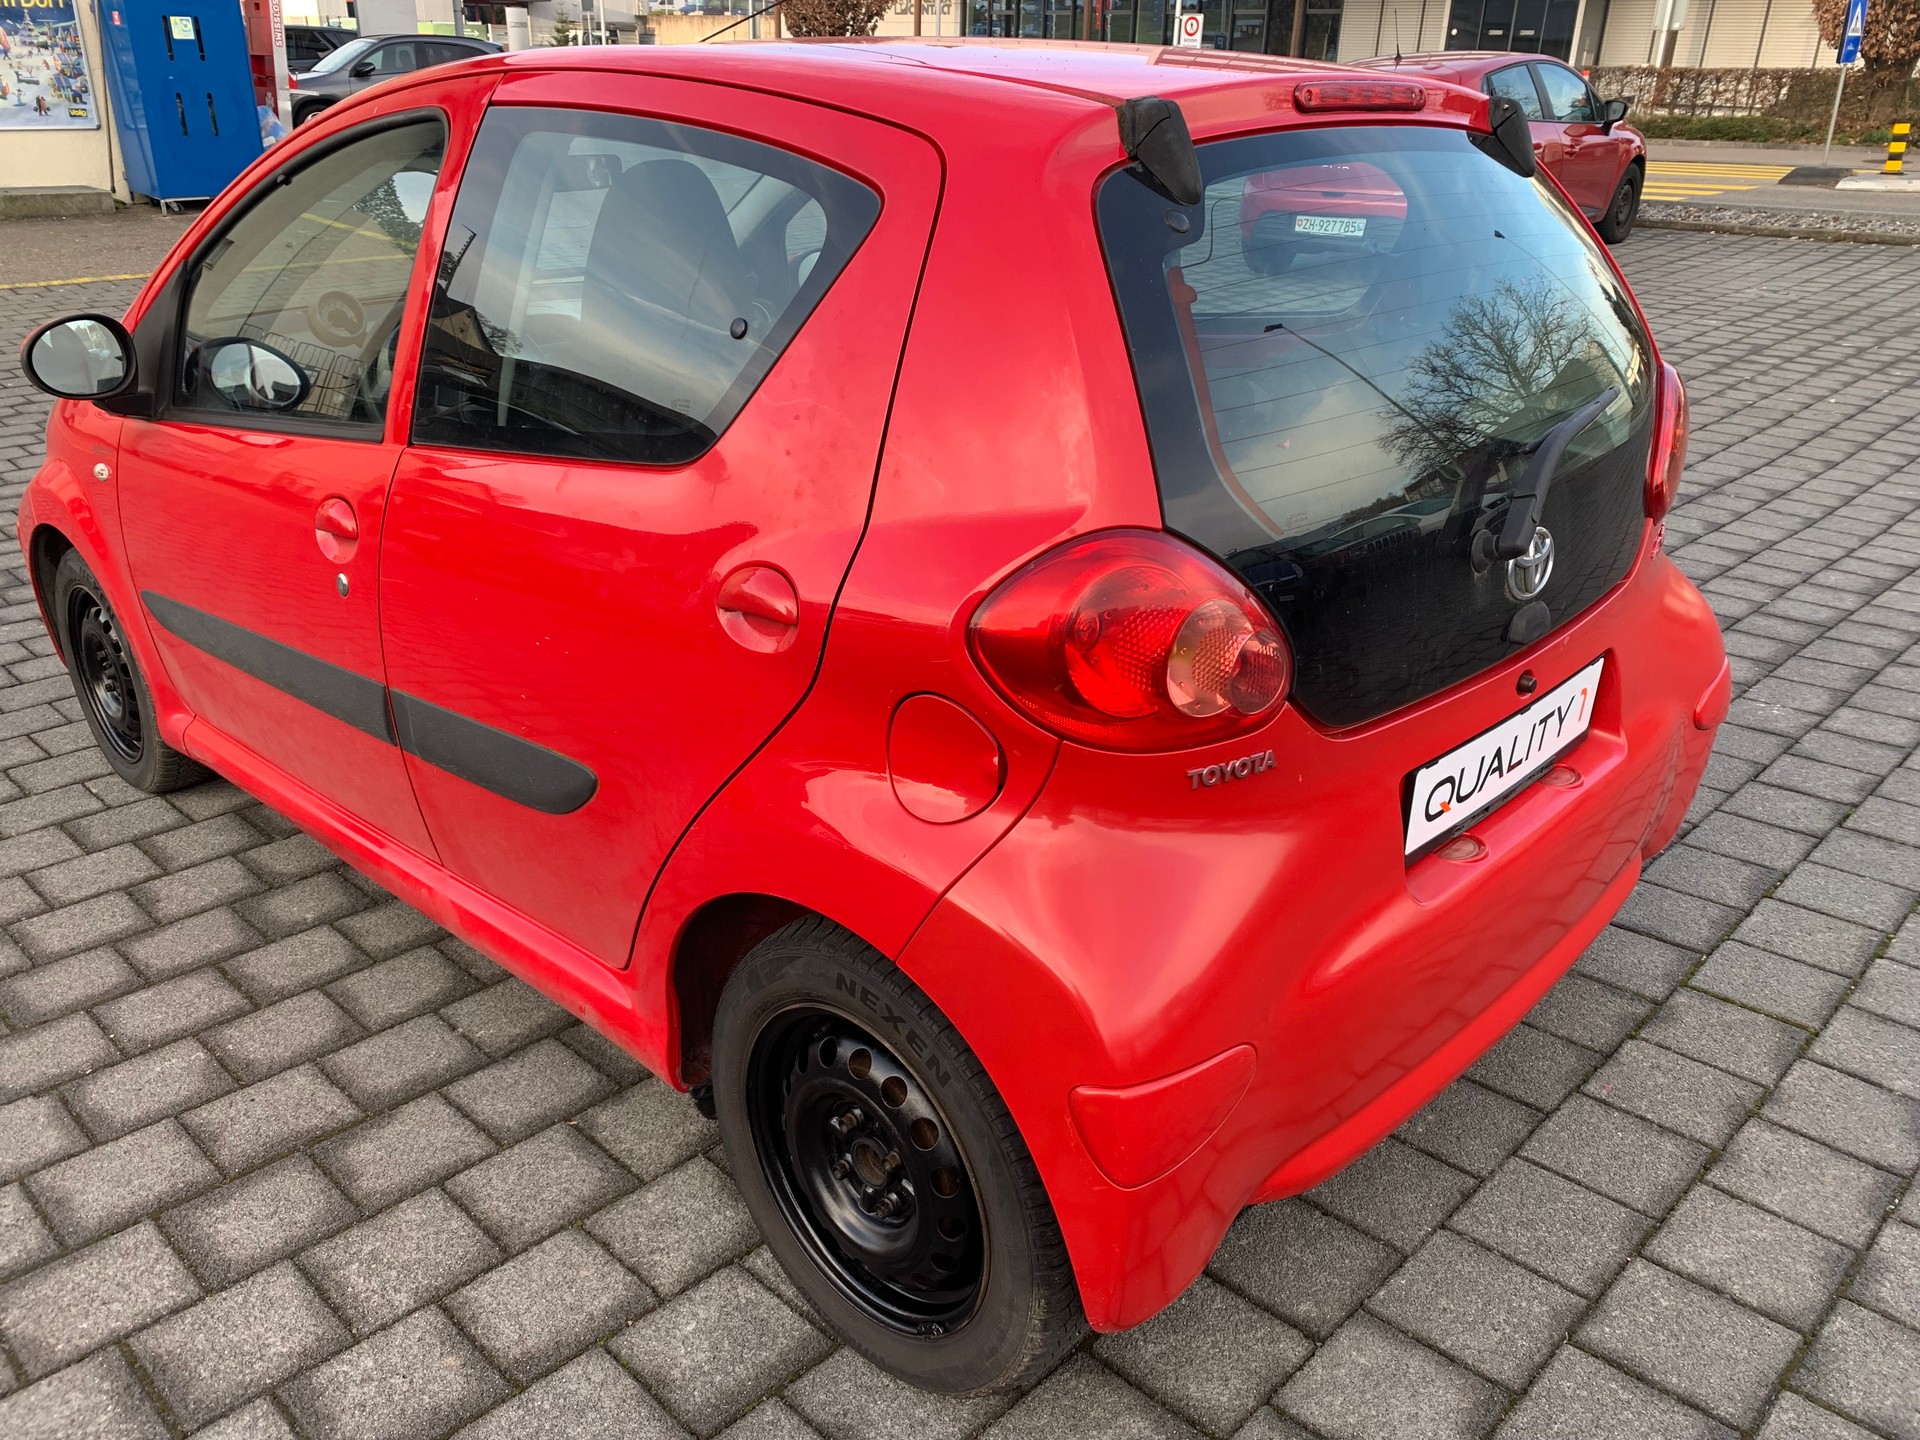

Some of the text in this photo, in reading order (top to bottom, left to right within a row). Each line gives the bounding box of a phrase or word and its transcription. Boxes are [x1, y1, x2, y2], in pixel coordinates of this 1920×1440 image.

[909, 4, 952, 15] CNTCT
[1187, 750, 1276, 789] TOYOTA
[835, 972, 952, 1088] NEXEN
